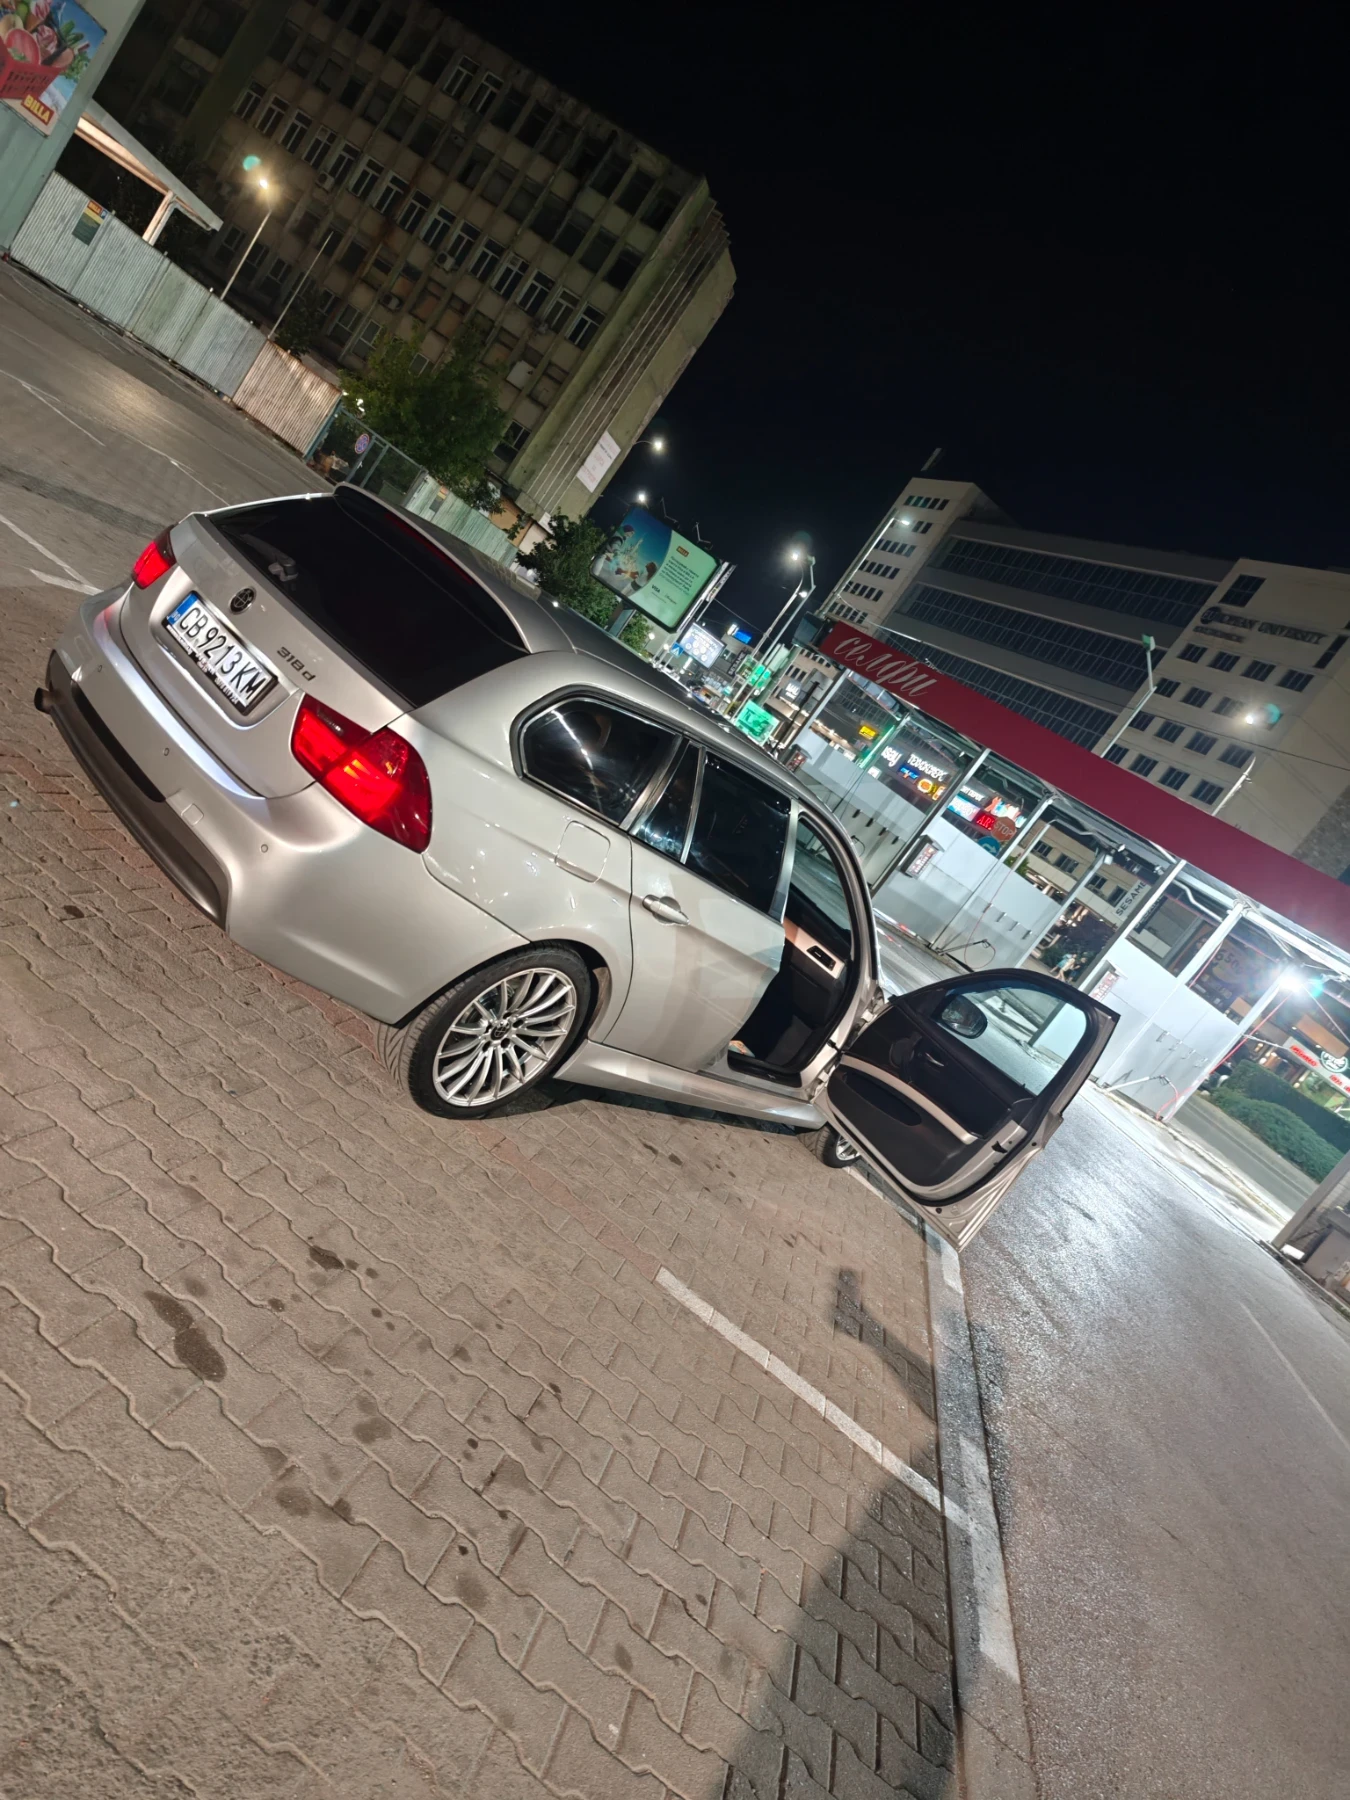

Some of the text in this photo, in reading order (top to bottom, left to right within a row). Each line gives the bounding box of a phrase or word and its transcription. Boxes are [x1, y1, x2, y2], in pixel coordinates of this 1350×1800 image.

[22, 93, 51, 123] BILLA
[727, 651, 746, 675] SESAME
[993, 820, 1015, 838] STOP
